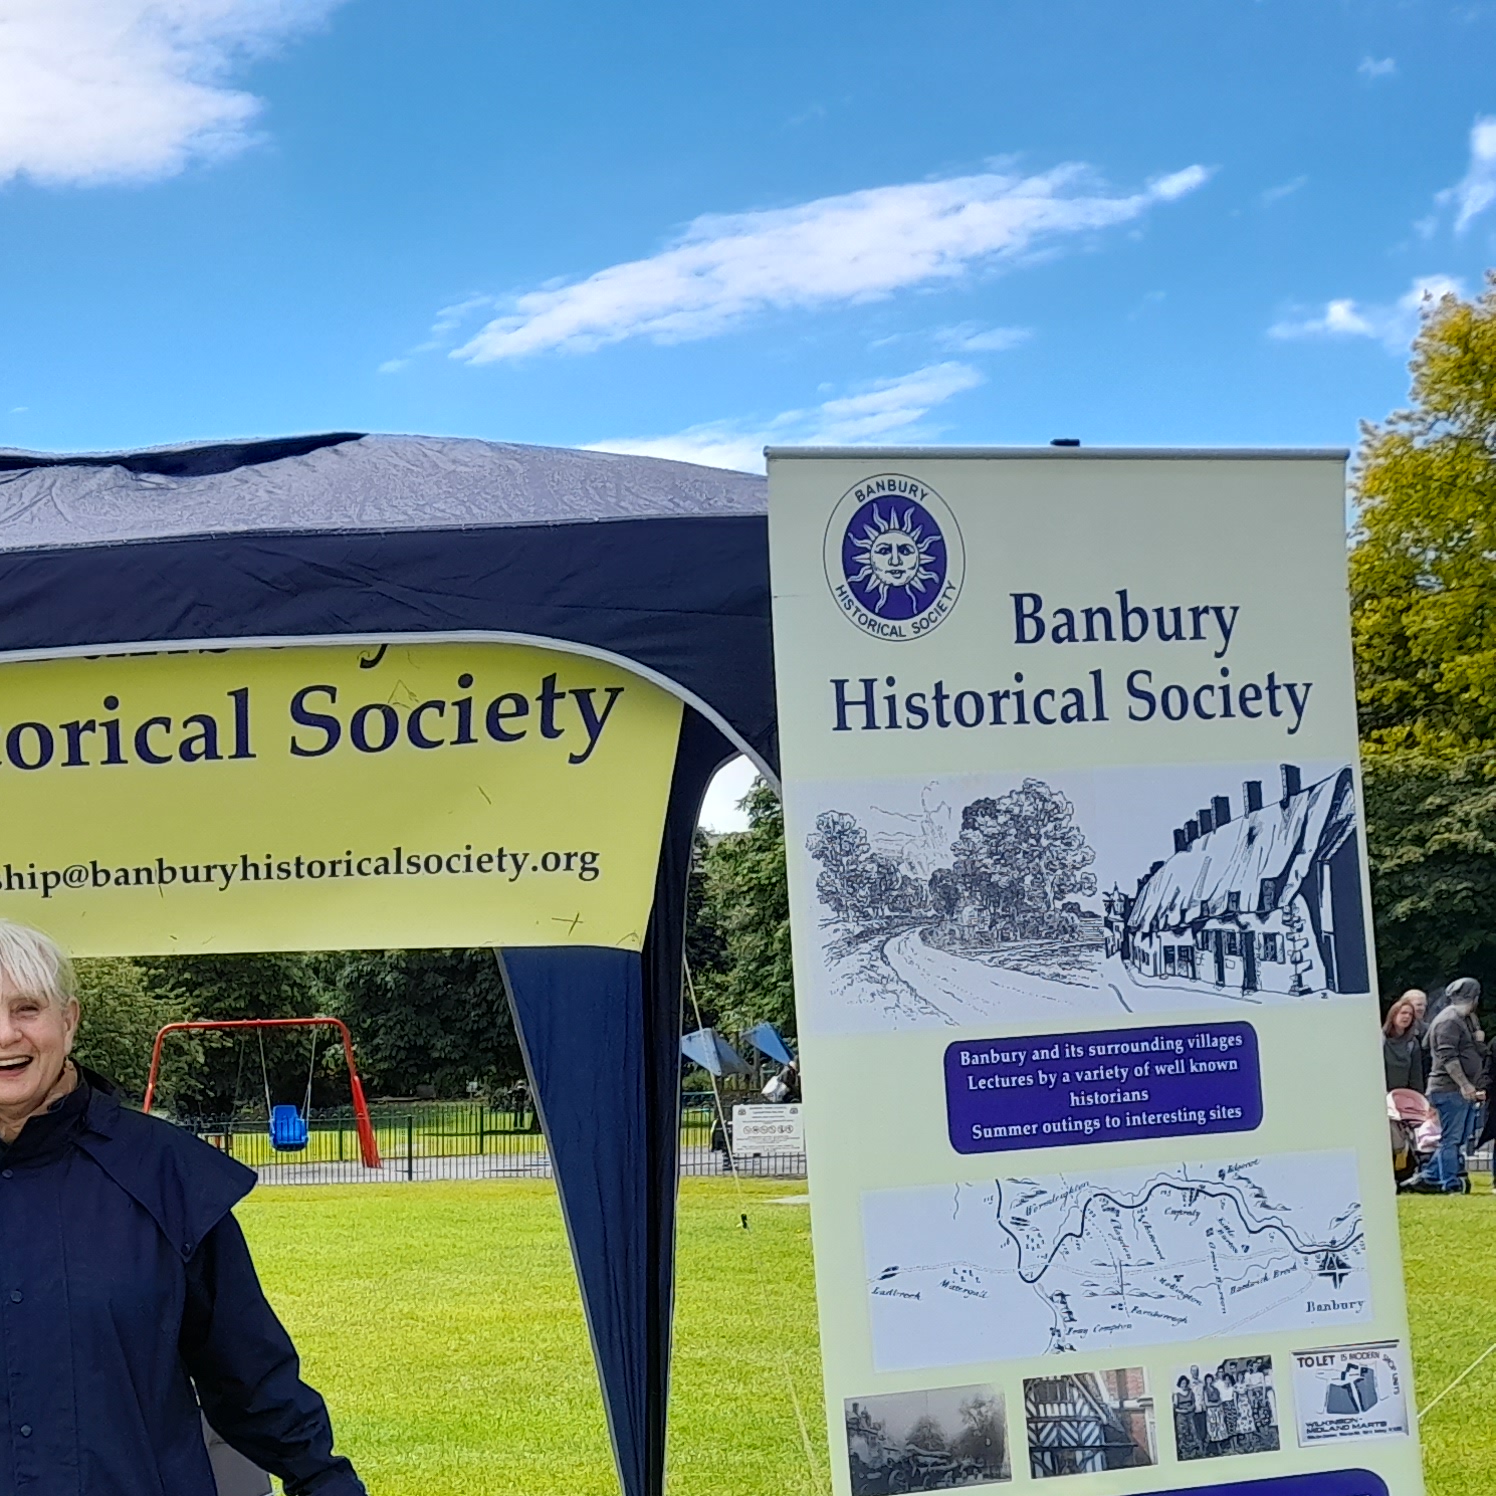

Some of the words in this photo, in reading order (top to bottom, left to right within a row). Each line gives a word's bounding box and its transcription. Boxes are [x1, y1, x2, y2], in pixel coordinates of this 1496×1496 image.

[855, 479, 929, 502] BANBURY
[835, 584, 906, 637] HISTORICAL
[911, 580, 956, 634] SOCIETY
[1009, 588, 1240, 659] Banbury
[829, 668, 1109, 731] Historical
[1126, 667, 1313, 735] Society
[290, 672, 625, 765] Society
[960, 1048, 1026, 1065] Banbury
[1031, 1044, 1059, 1060] and
[1065, 1043, 1083, 1057] its
[1088, 1036, 1183, 1056] surrounding
[1187, 1033, 1242, 1050] villages
[968, 1075, 1033, 1089] Lectures
[1037, 1070, 1056, 1088] by
[1062, 1072, 1070, 1082] a
[1075, 1065, 1128, 1082] variety
[1134, 1061, 1149, 1076] of
[1154, 1059, 1184, 1074] well
[1189, 1058, 1237, 1072] known
[1069, 1088, 1148, 1106] historians
[972, 1124, 1037, 1138] Summer
[1042, 1117, 1100, 1134] outings
[1105, 1115, 1120, 1127] to
[1125, 1107, 1205, 1125] interesting
[1209, 1105, 1241, 1119] sites
[1306, 1299, 1365, 1314] Banbury
[1316, 1355, 1336, 1367] LET
